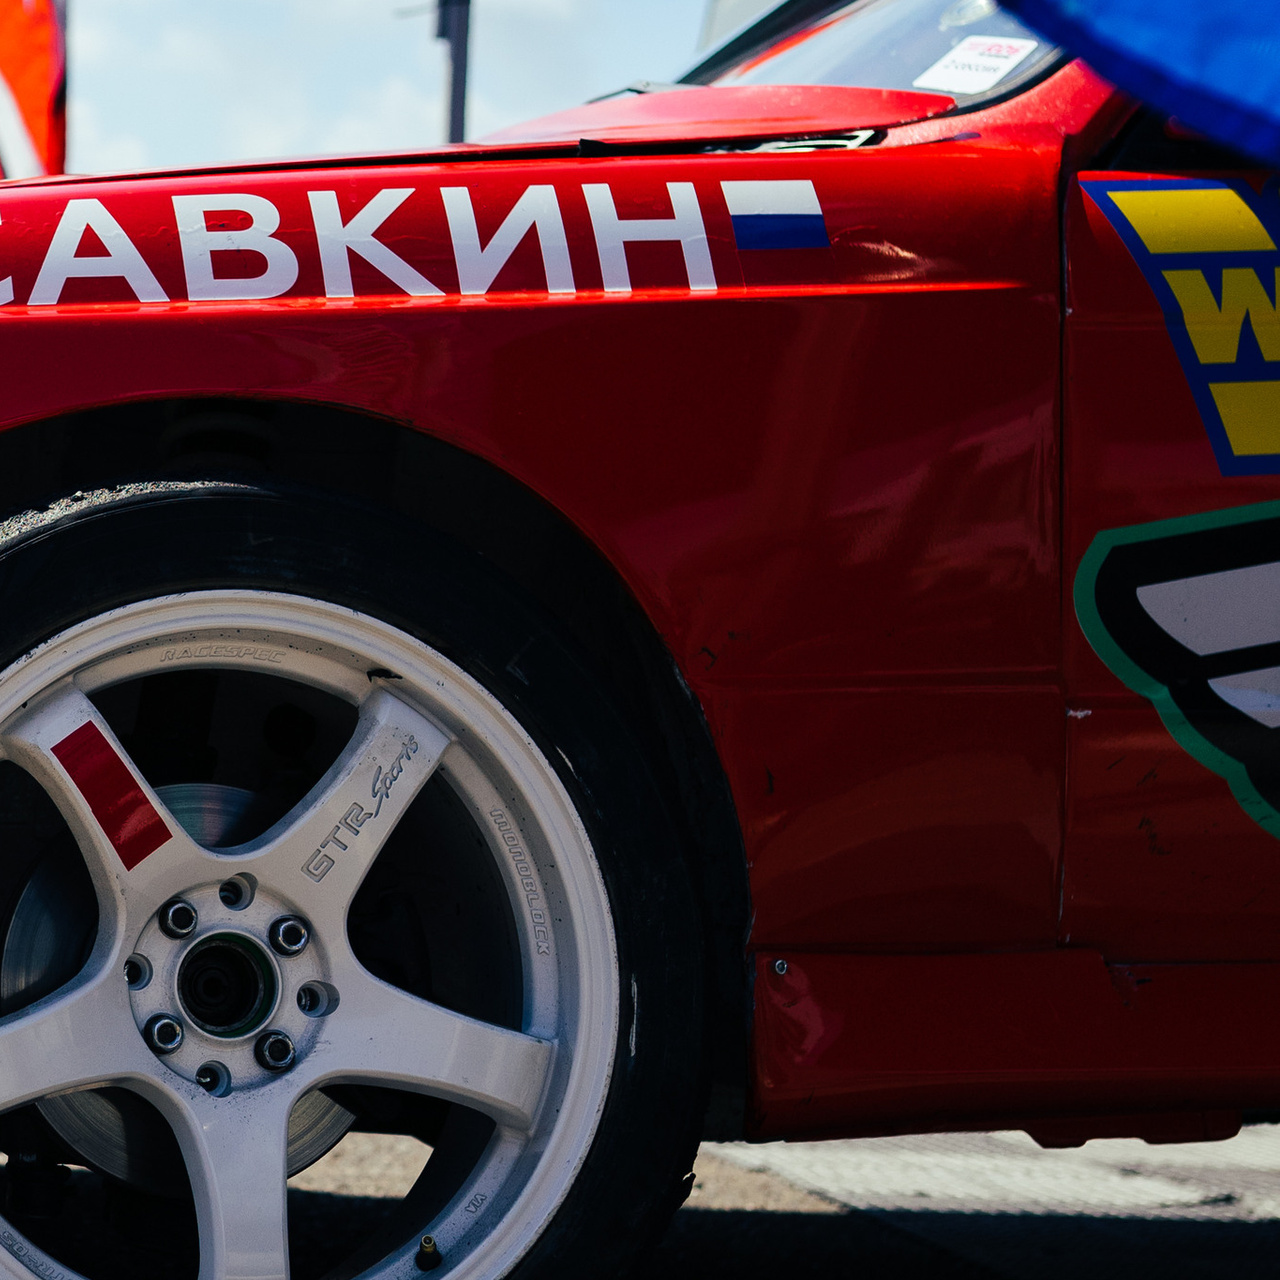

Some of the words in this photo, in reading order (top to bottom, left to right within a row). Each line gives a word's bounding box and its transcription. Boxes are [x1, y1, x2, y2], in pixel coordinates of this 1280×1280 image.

[160, 643, 286, 663] RACESPEC
[300, 802, 373, 883] GTR
[372, 734, 418, 818] Sports
[490, 808, 550, 956] MONOBLOCK
